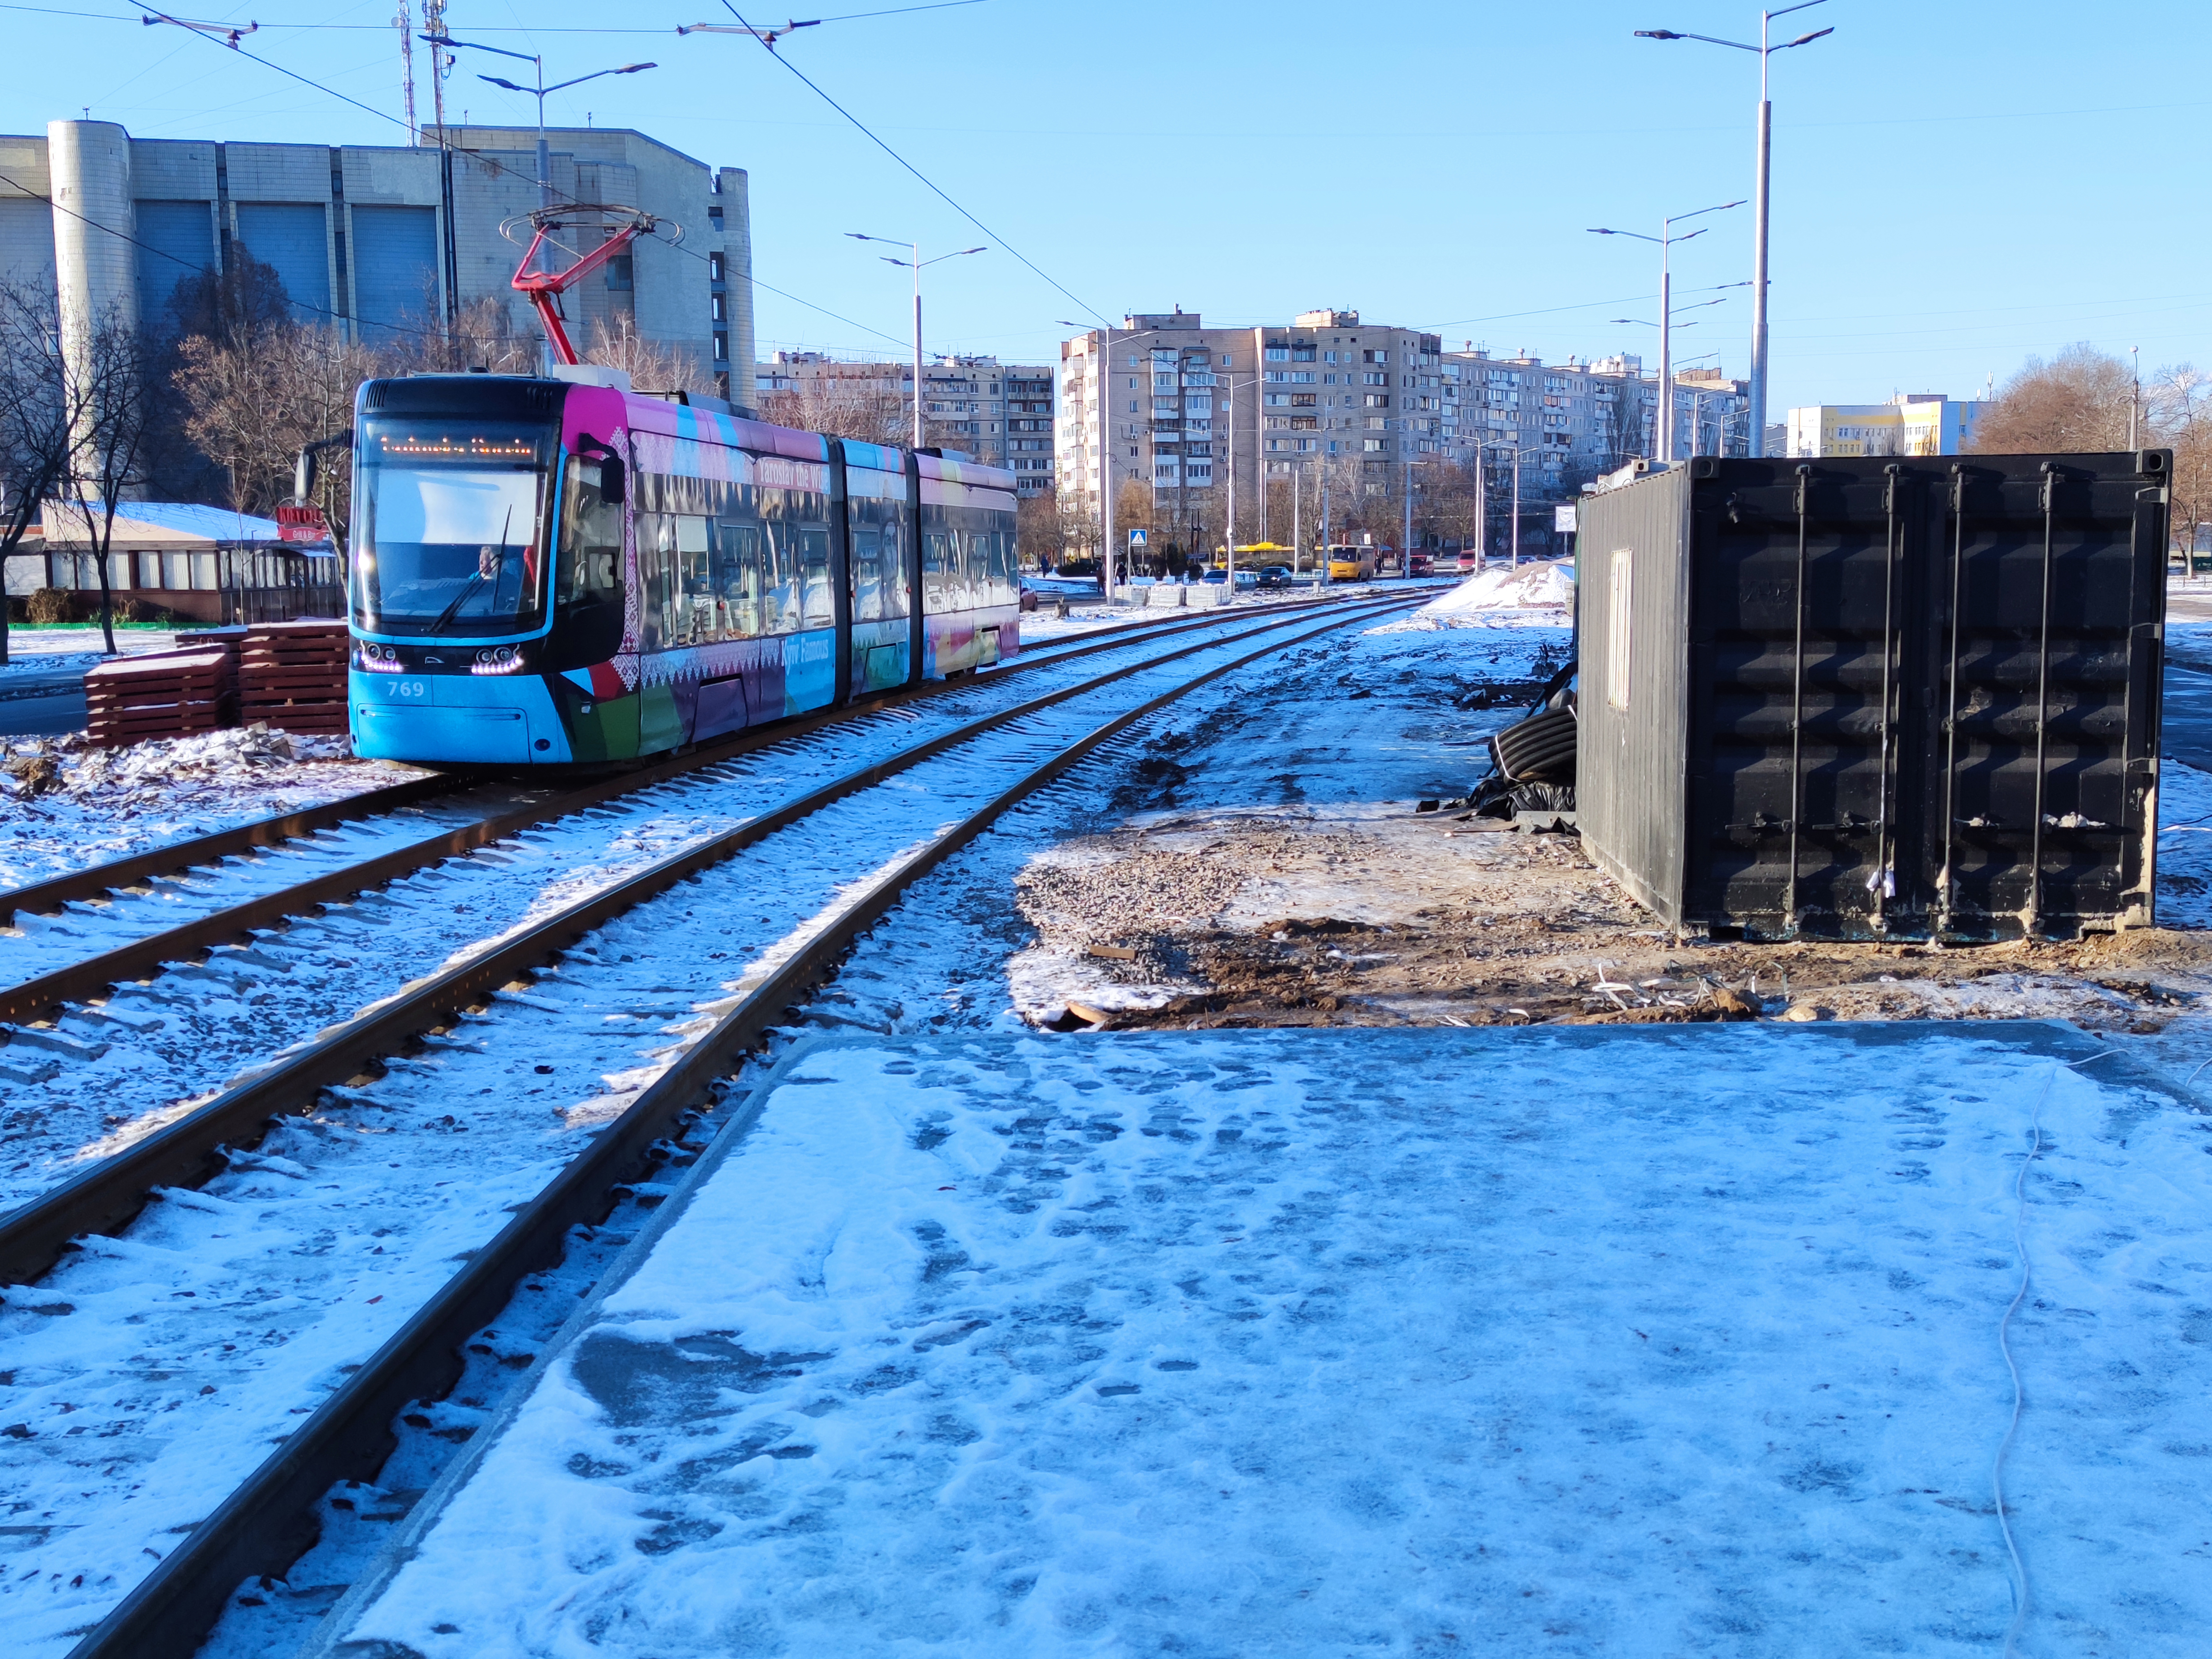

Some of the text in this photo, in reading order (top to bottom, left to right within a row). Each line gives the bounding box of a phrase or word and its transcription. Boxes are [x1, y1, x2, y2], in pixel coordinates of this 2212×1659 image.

[760, 459, 794, 486] Yaroslav
[796, 464, 809, 488] the
[781, 637, 828, 676] Kyiv Famous
[387, 682, 424, 697] 769
